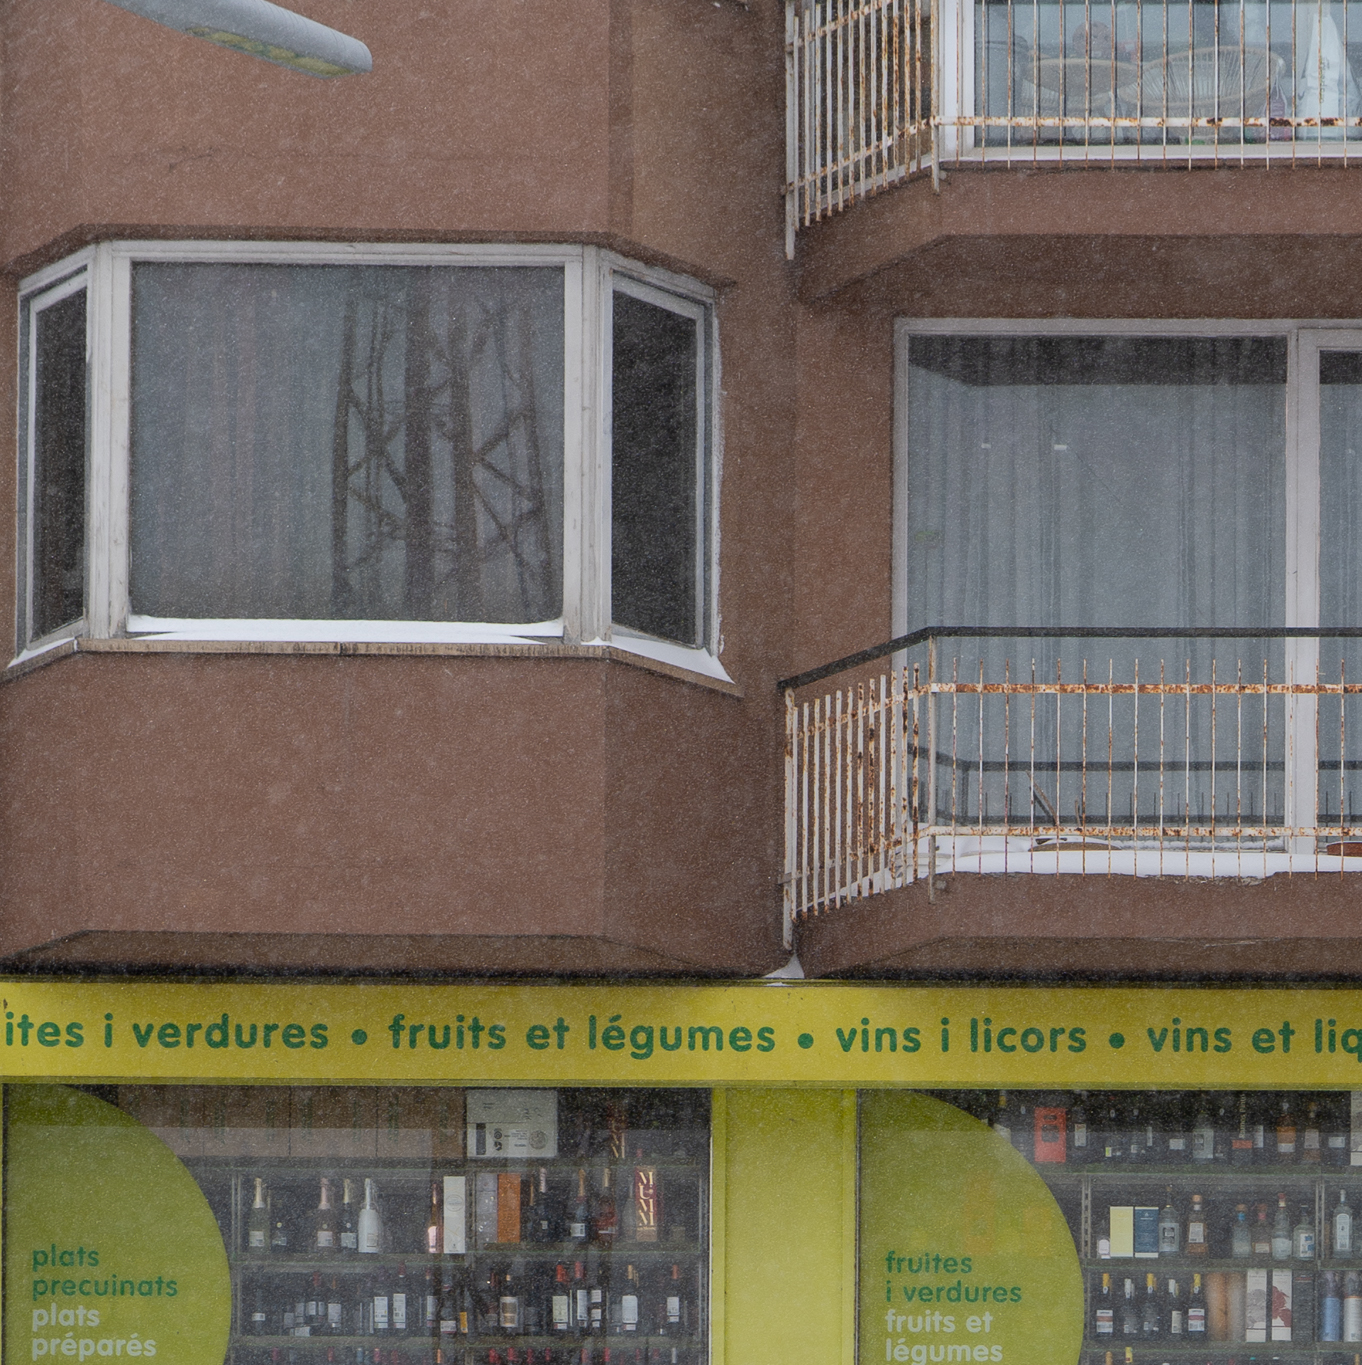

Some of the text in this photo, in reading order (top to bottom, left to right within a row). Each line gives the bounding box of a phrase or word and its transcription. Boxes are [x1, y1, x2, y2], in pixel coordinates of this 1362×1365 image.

[104, 1012, 114, 1048] i
[132, 1012, 329, 1050] verdures
[388, 1014, 507, 1051] fruits
[526, 1017, 570, 1051] et
[588, 1014, 776, 1060] légumes
[835, 1017, 922, 1053] vins
[940, 1017, 950, 1053] i
[969, 1017, 1087, 1054] licors
[1146, 1017, 1232, 1054] vins
[1252, 1020, 1296, 1055] et
[638, 1171, 655, 1226] MUMM
[32, 1243, 100, 1272] plats
[885, 1250, 973, 1274] fruites
[32, 1274, 178, 1301] precuinats
[886, 1279, 1022, 1303] i verdures
[32, 1302, 100, 1332] plats
[885, 1309, 993, 1333] fruits et
[32, 1332, 157, 1362] préparés
